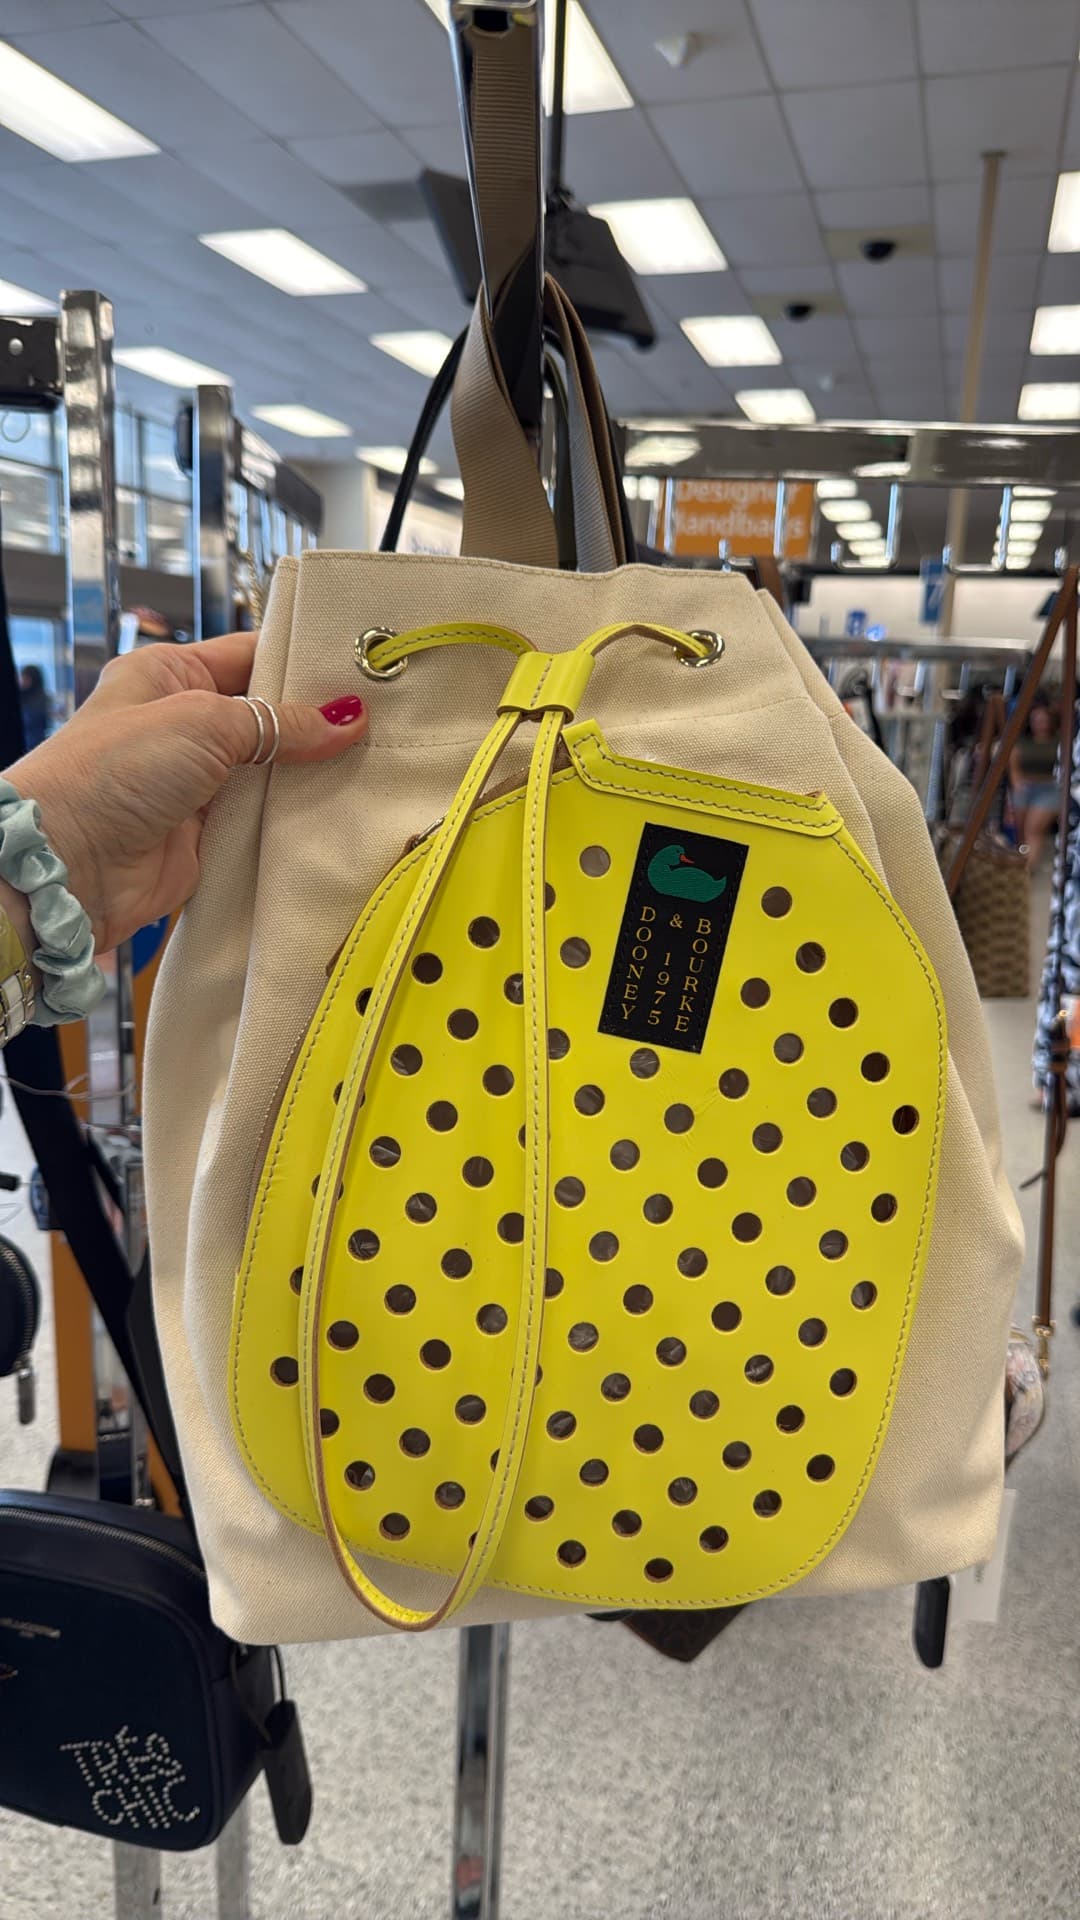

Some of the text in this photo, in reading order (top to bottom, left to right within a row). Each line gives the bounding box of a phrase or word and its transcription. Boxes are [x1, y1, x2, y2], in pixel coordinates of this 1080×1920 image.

[669, 913, 684, 929] &
[620, 906, 656, 1020] DOONEY
[647, 952, 670, 1025] 1975
[674, 918, 712, 1032] BOURKE
[91, 1774, 200, 1829] CHIC
